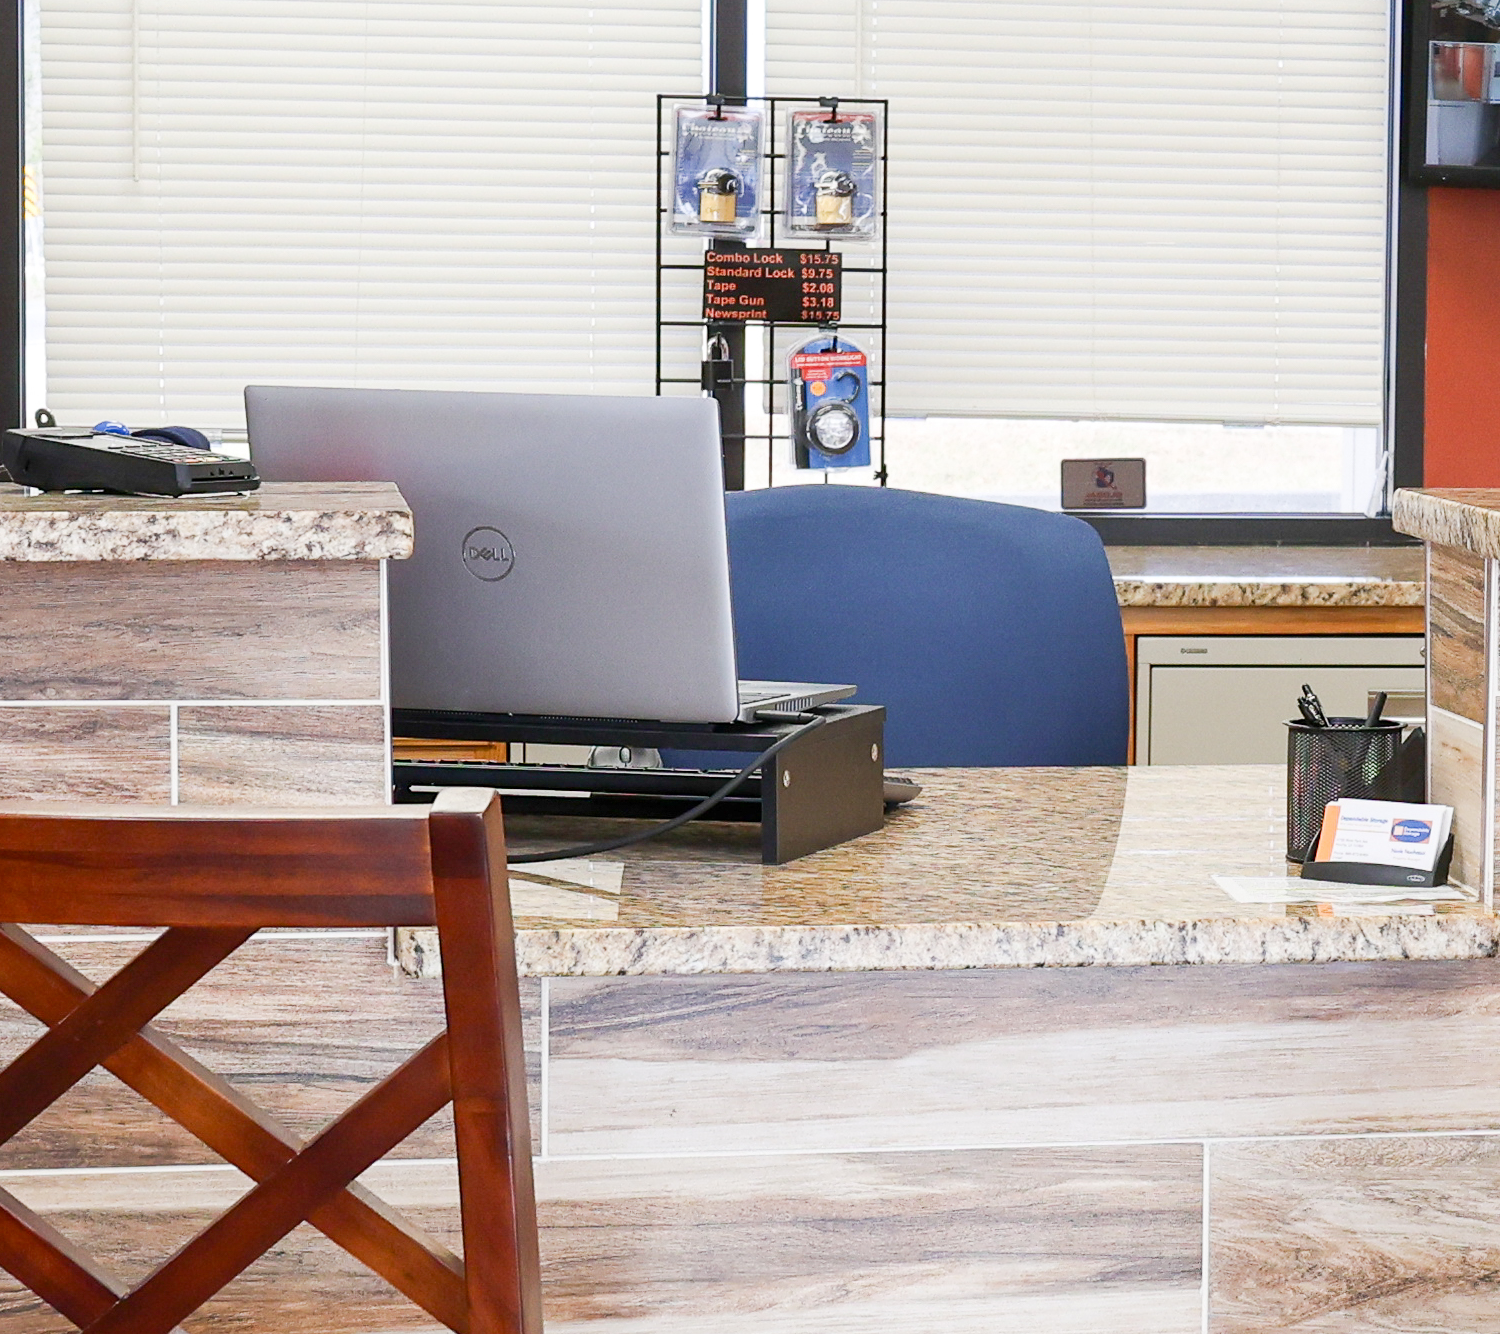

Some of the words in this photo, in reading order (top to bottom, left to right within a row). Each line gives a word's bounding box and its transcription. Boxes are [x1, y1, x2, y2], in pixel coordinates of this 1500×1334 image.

[706, 251, 751, 264] Combo
[753, 253, 783, 264] Lock
[800, 253, 839, 265] $15.75
[707, 266, 762, 278] Standard
[765, 267, 795, 279] Lock
[801, 268, 834, 280] $9.75
[707, 279, 737, 292] Tape
[802, 282, 834, 294] $2.08
[706, 293, 736, 306] Tape
[739, 295, 765, 306] Gun
[802, 297, 835, 308] $3.18
[705, 307, 767, 320] Newsprint
[469, 546, 510, 562] DELL
